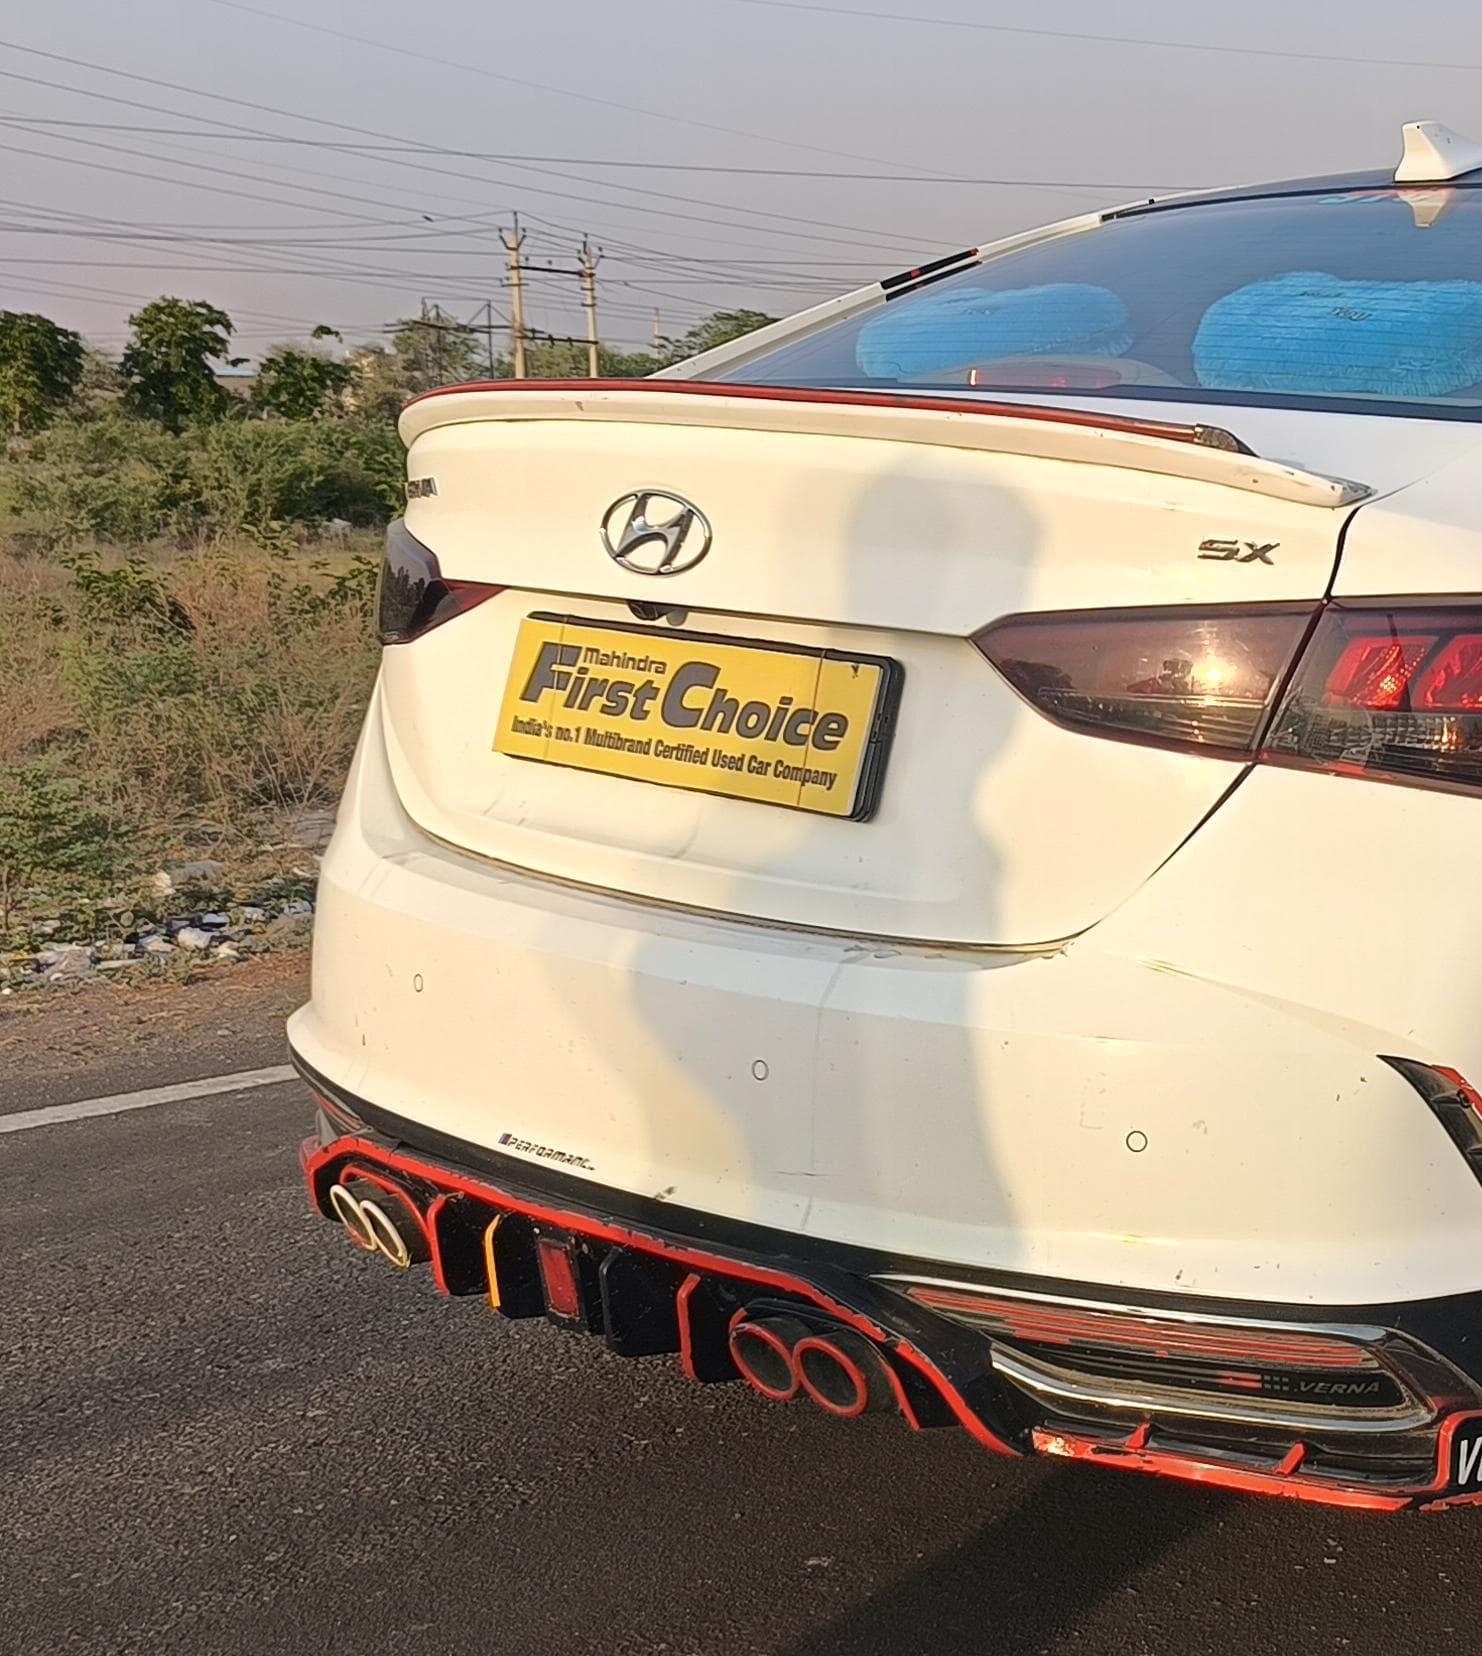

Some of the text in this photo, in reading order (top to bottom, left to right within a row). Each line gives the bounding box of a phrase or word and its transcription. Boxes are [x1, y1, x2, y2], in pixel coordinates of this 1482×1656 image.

[1197, 539, 1281, 566] SX
[583, 647, 668, 675] Mahindra
[520, 641, 849, 751] First Choice
[511, 715, 837, 791] India's no.1 Multibrand Certified Used Car Company
[1300, 1381, 1380, 1394] VERNA
